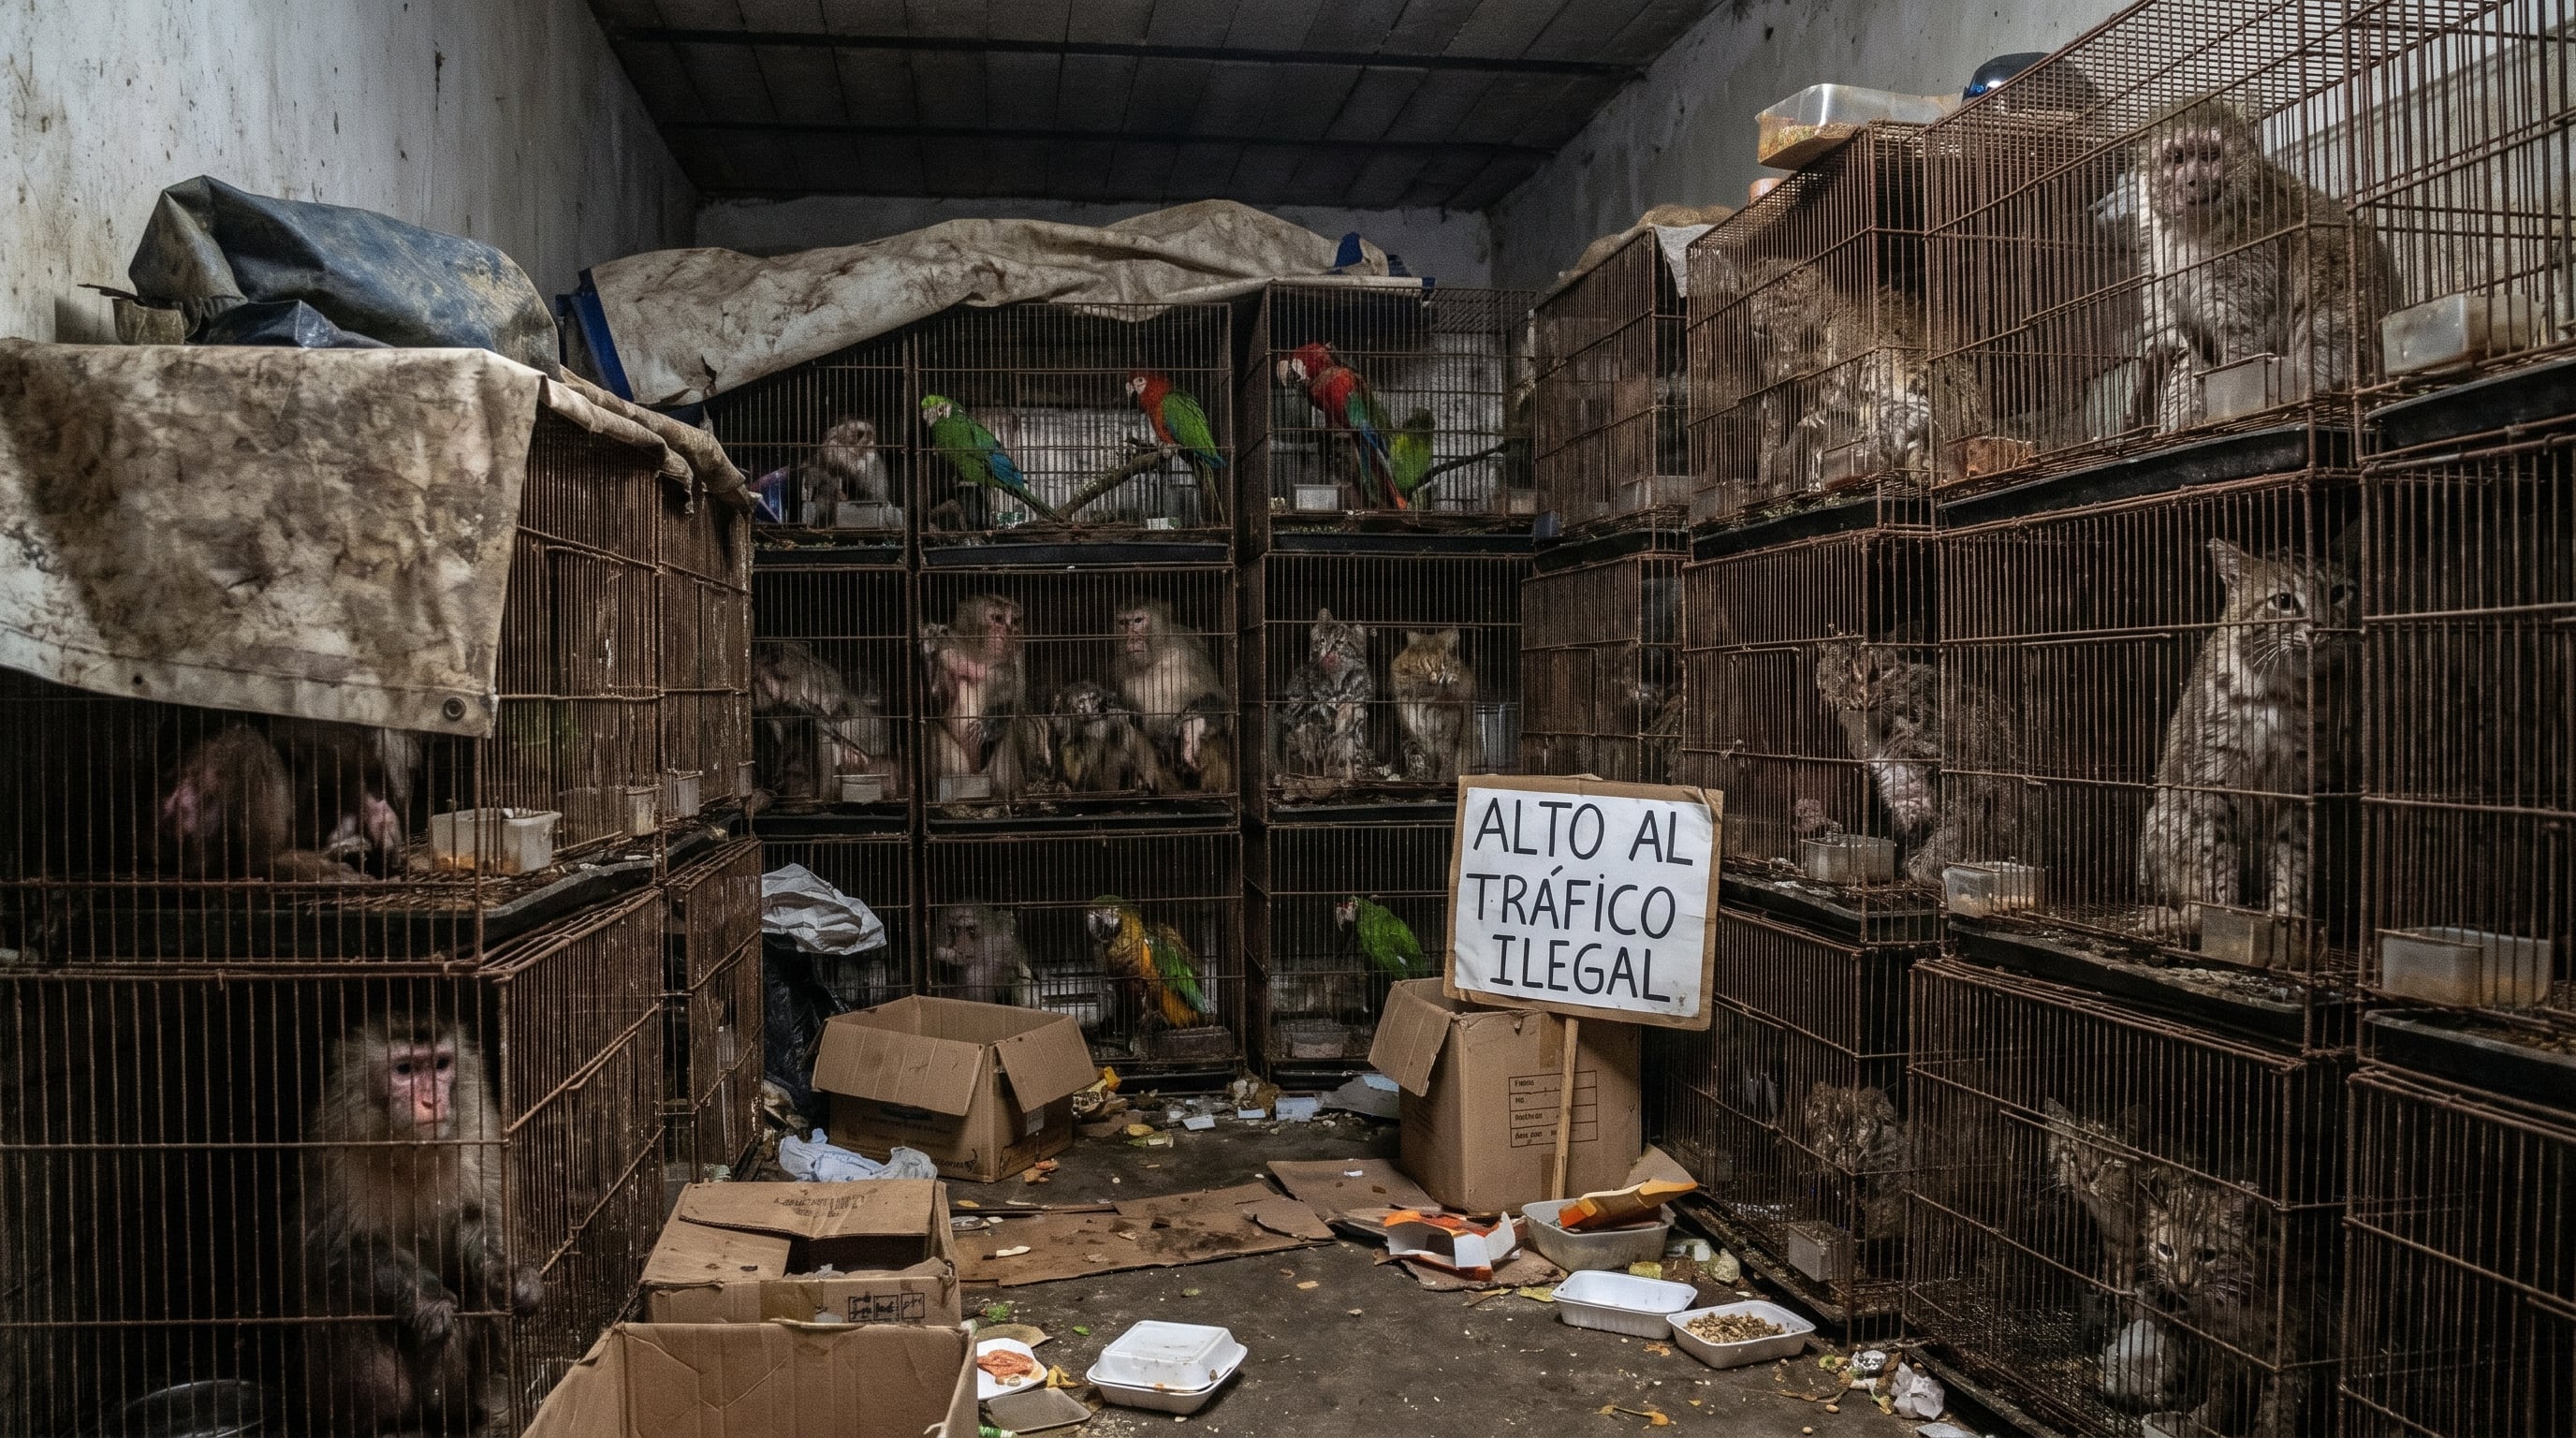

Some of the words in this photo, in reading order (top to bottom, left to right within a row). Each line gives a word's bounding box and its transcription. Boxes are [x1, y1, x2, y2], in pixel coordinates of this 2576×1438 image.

[1473, 798, 1604, 859] ALTO
[1628, 810, 1693, 866] AL
[1489, 934, 1671, 1003] ILEGAL
